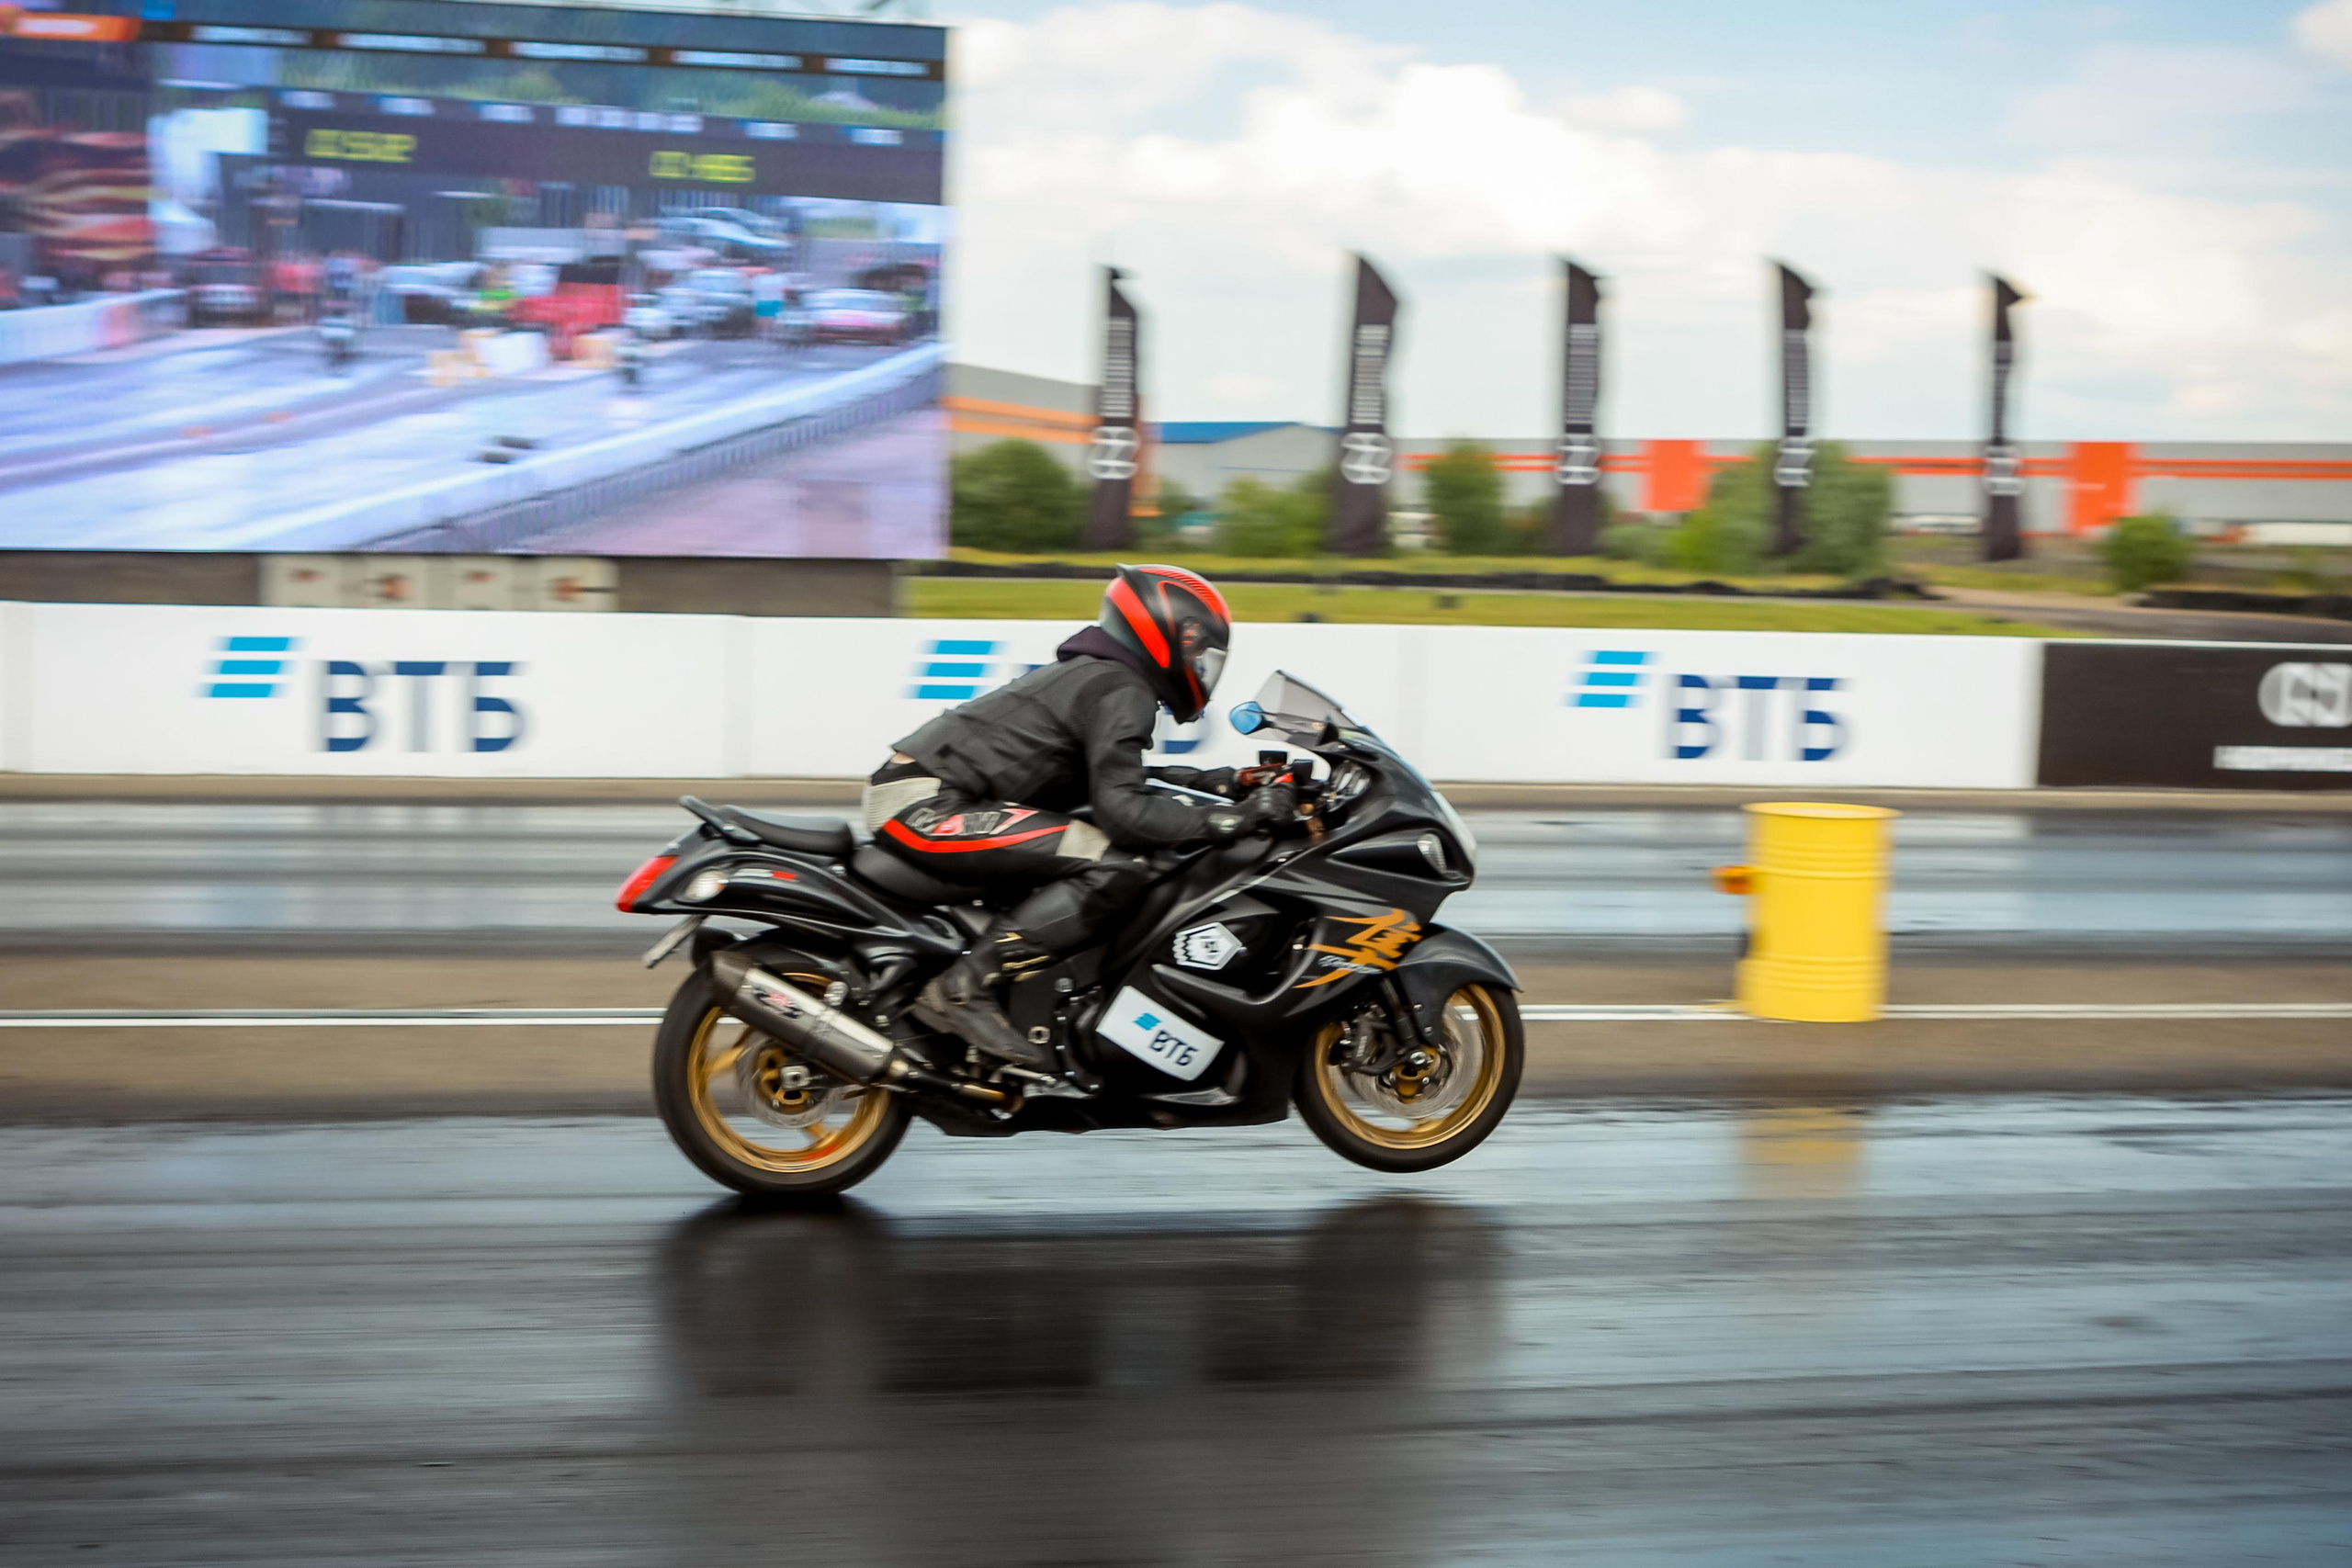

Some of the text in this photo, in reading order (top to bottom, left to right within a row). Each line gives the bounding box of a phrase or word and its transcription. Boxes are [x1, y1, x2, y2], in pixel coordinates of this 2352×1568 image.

[314, 660, 531, 752] ВТБ
[1663, 673, 1854, 761] ВТБ
[1149, 1030, 1199, 1066] ВТБ
